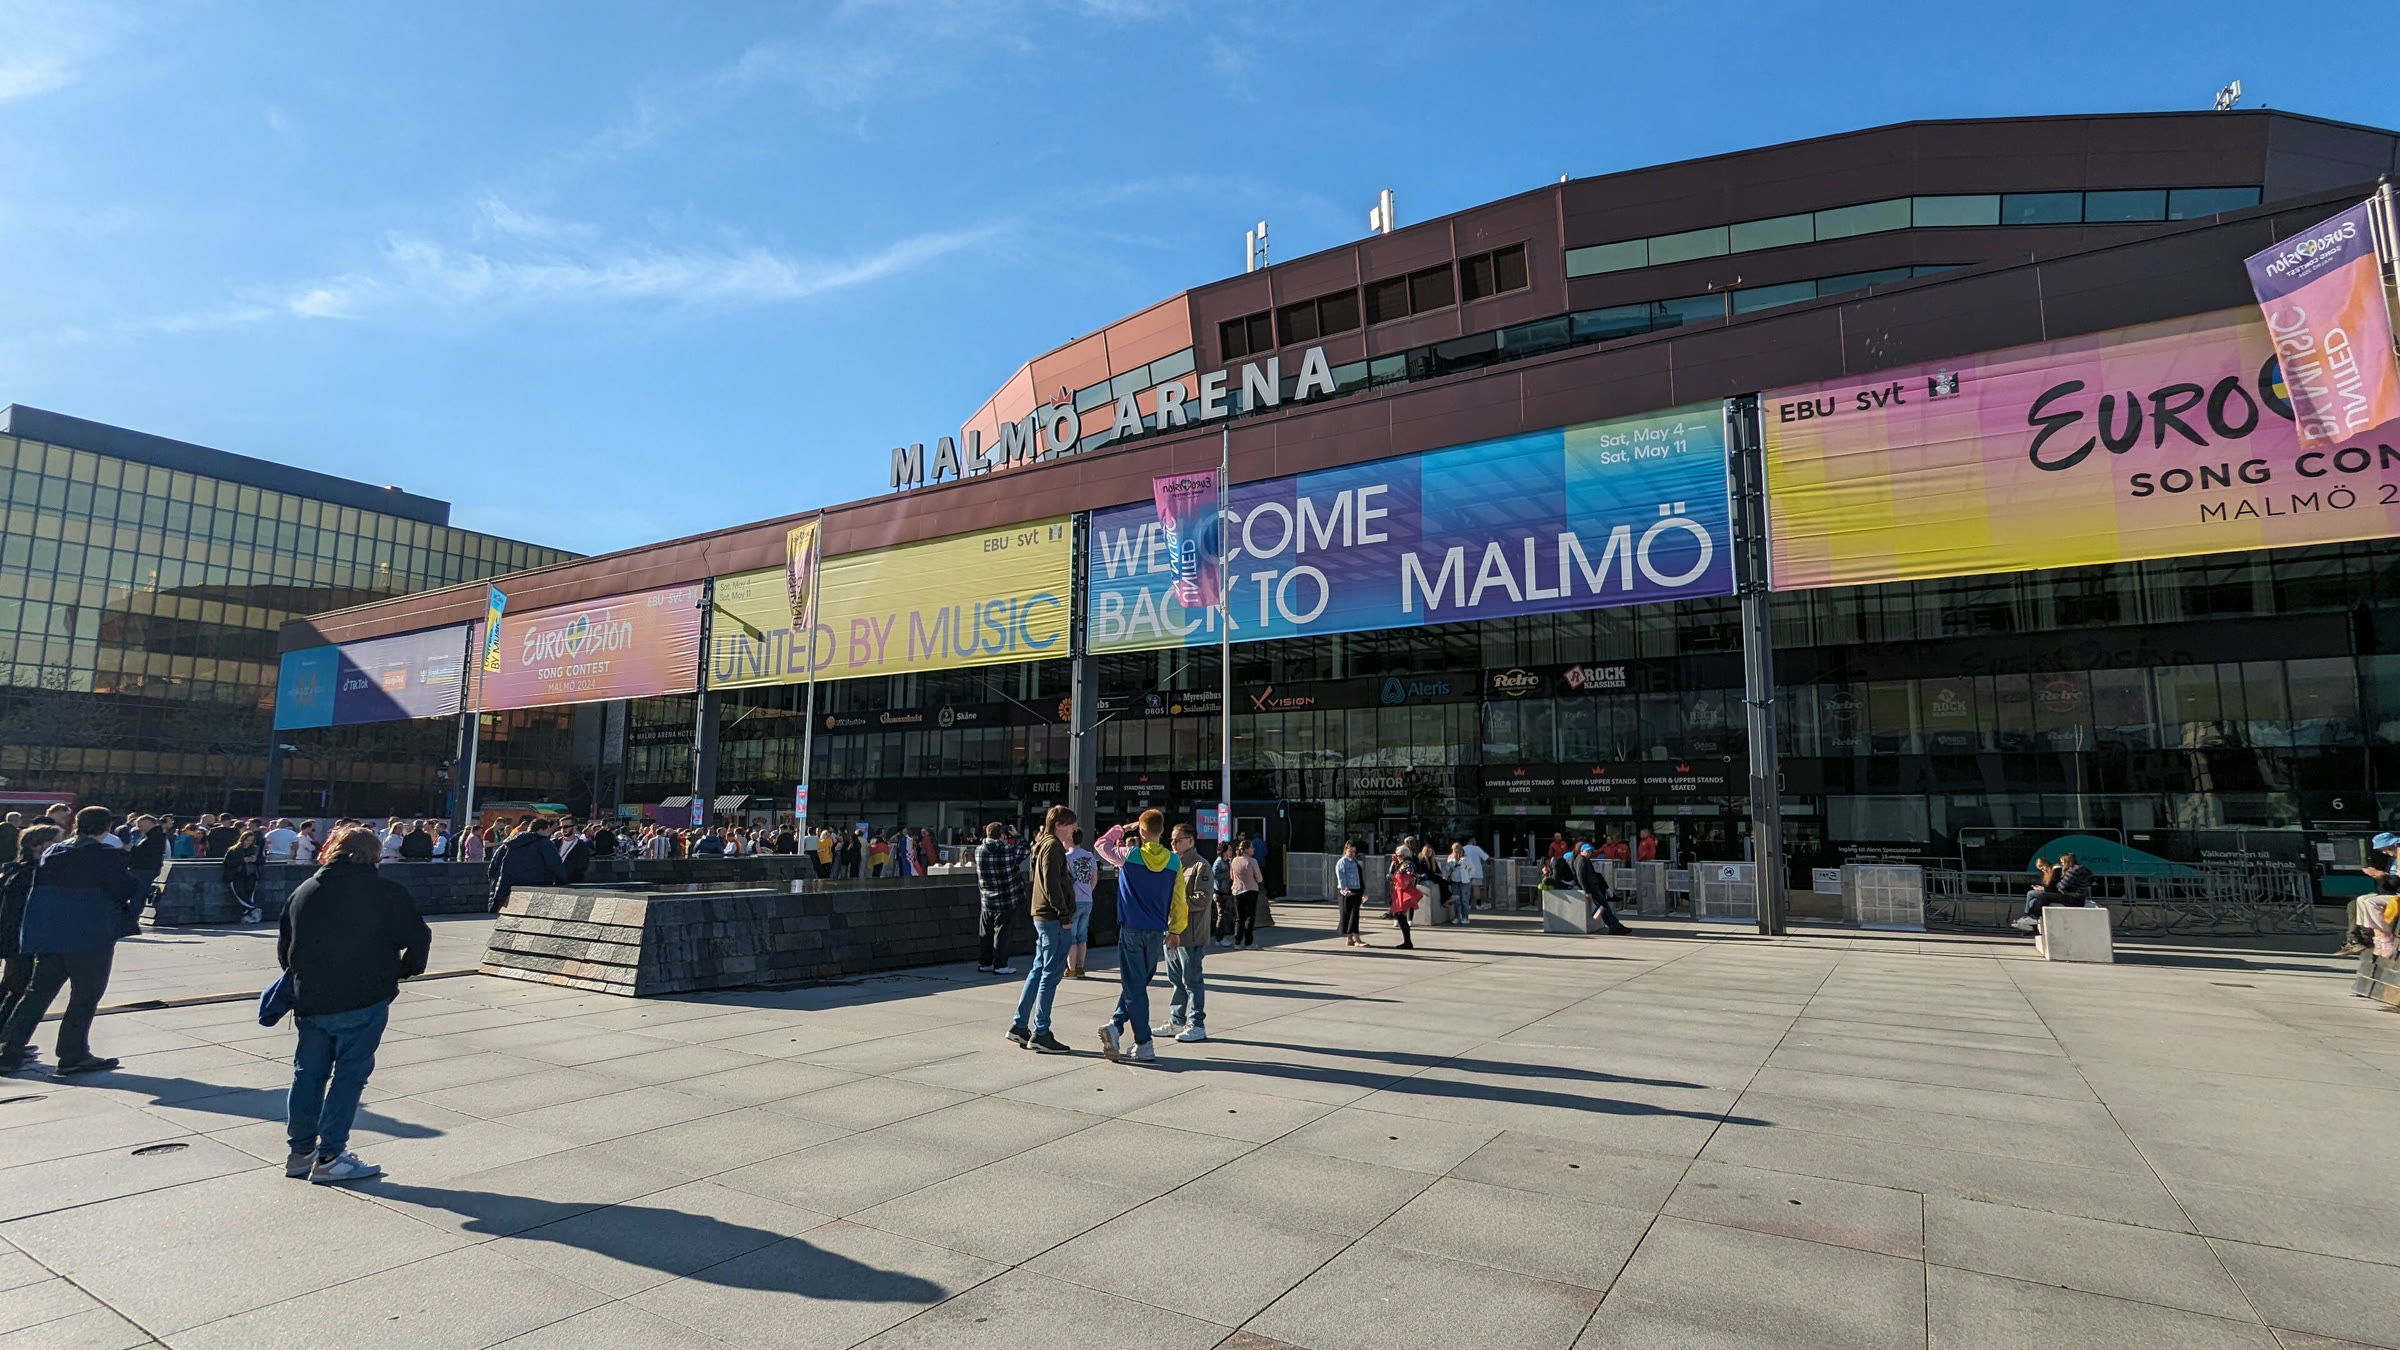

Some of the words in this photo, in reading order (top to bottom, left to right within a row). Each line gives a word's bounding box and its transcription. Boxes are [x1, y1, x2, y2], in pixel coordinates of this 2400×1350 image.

[1780, 397, 1835, 423] EBU
[1856, 382, 1906, 410] svt
[891, 386, 1081, 488] MALMÖ
[1110, 346, 1336, 439] ARENA
[1600, 433, 1630, 448] Sat,
[1634, 427, 1670, 446] May
[1672, 423, 1685, 436] 4
[1600, 450, 1630, 465] Sat,
[1634, 444, 1670, 463] May
[1674, 440, 1687, 454] 11
[2131, 459, 2271, 497] SONG
[2200, 485, 2355, 523] MALMÖ
[1099, 484, 1388, 579] WECOME
[983, 536, 1009, 552] EBU
[1017, 528, 1039, 547] svt
[1401, 501, 1713, 613] MALMÖ
[648, 595, 663, 607] EBU
[732, 591, 745, 600] May
[1251, 565, 1329, 628] TO
[713, 623, 836, 681] UNITED
[848, 613, 897, 669] BY
[908, 593, 1062, 663] MUSIC
[491, 657, 499, 669] BY
[538, 666, 563, 680] SONG
[566, 661, 610, 677] CONTEST
[1584, 666, 1625, 681] ROCK
[548, 680, 575, 692] MALMÖ
[578, 680, 596, 690] 2024
[1494, 673, 1538, 687] Retro
[1584, 680, 1626, 689] KLASSIKER
[1407, 681, 1450, 697] Aleris
[1145, 707, 1165, 715] OBOS
[1932, 702, 1966, 712] ROCK
[956, 712, 977, 720] Skåne
[1033, 783, 1061, 793] ENTRE
[1181, 780, 1214, 790] ENTRE
[1353, 777, 1403, 788] KONTOR
[2332, 798, 2344, 810] 6
[2266, 860, 2296, 868] Rehab
